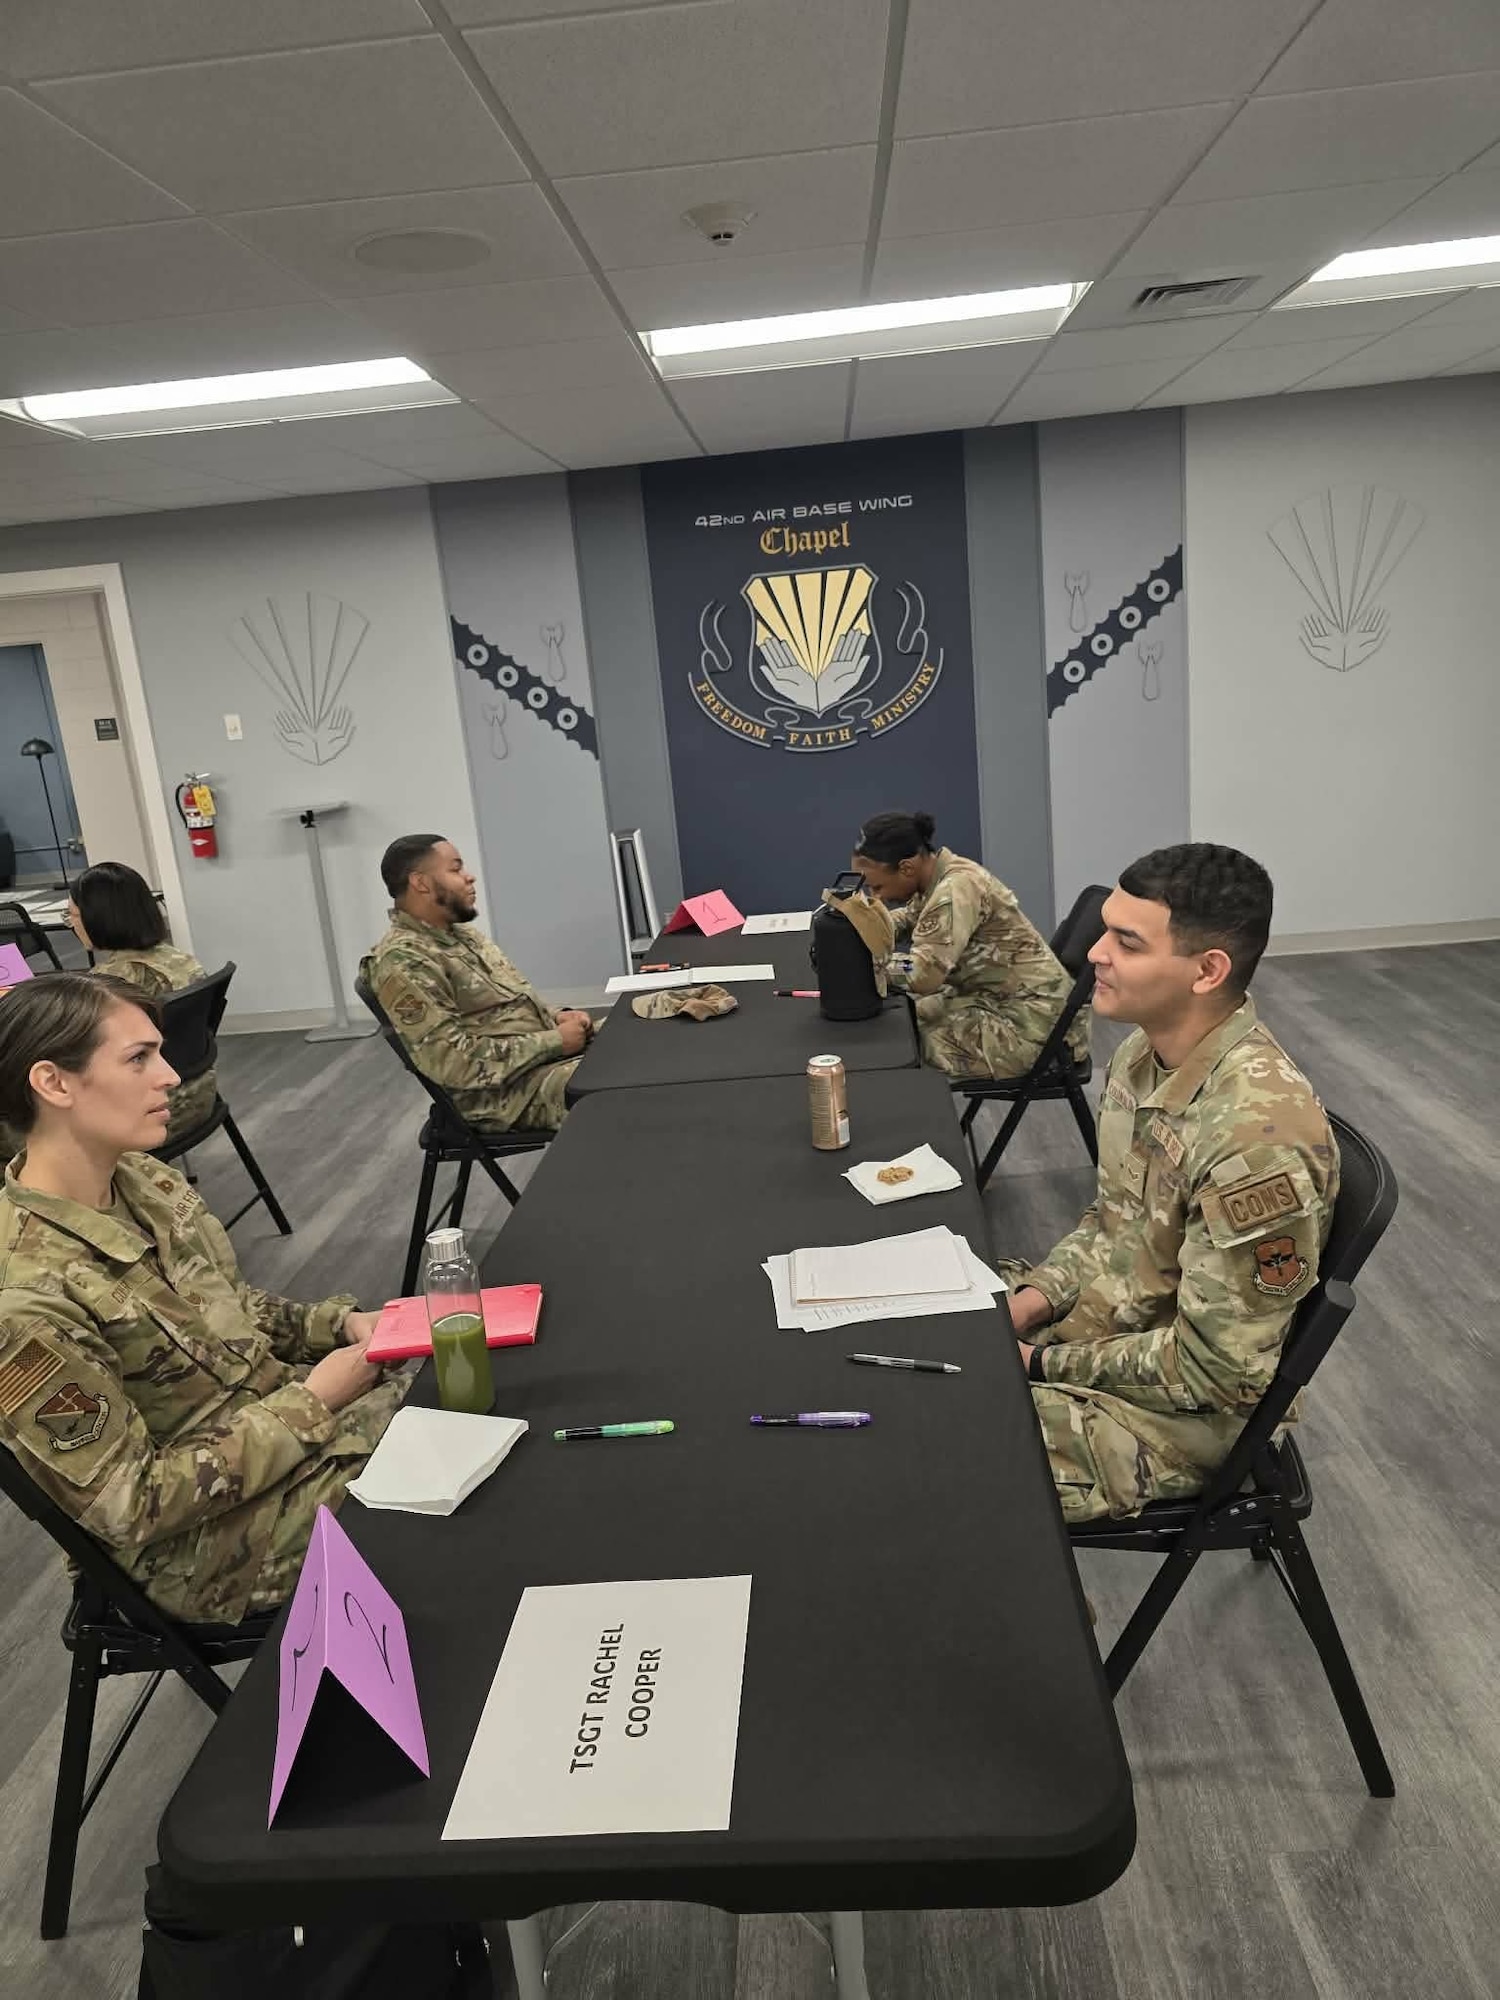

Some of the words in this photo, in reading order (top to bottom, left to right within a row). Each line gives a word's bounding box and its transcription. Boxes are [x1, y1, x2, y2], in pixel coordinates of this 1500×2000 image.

[694, 515, 746, 527] 42ND
[752, 508, 786, 522] AIR
[793, 501, 853, 518] BASE
[858, 495, 913, 511] WING
[759, 521, 851, 557] Chapel
[696, 681, 767, 740] FREEDOM
[788, 728, 852, 745] FAITH
[871, 661, 936, 730] MINISTRY
[702, 900, 727, 924] 1
[174, 1201, 191, 1220] AIR
[1230, 1182, 1294, 1222] CONS
[586, 1623, 624, 1704] RACHEL
[625, 1648, 662, 1738] COOPER
[569, 1712, 604, 1774] TSGT
